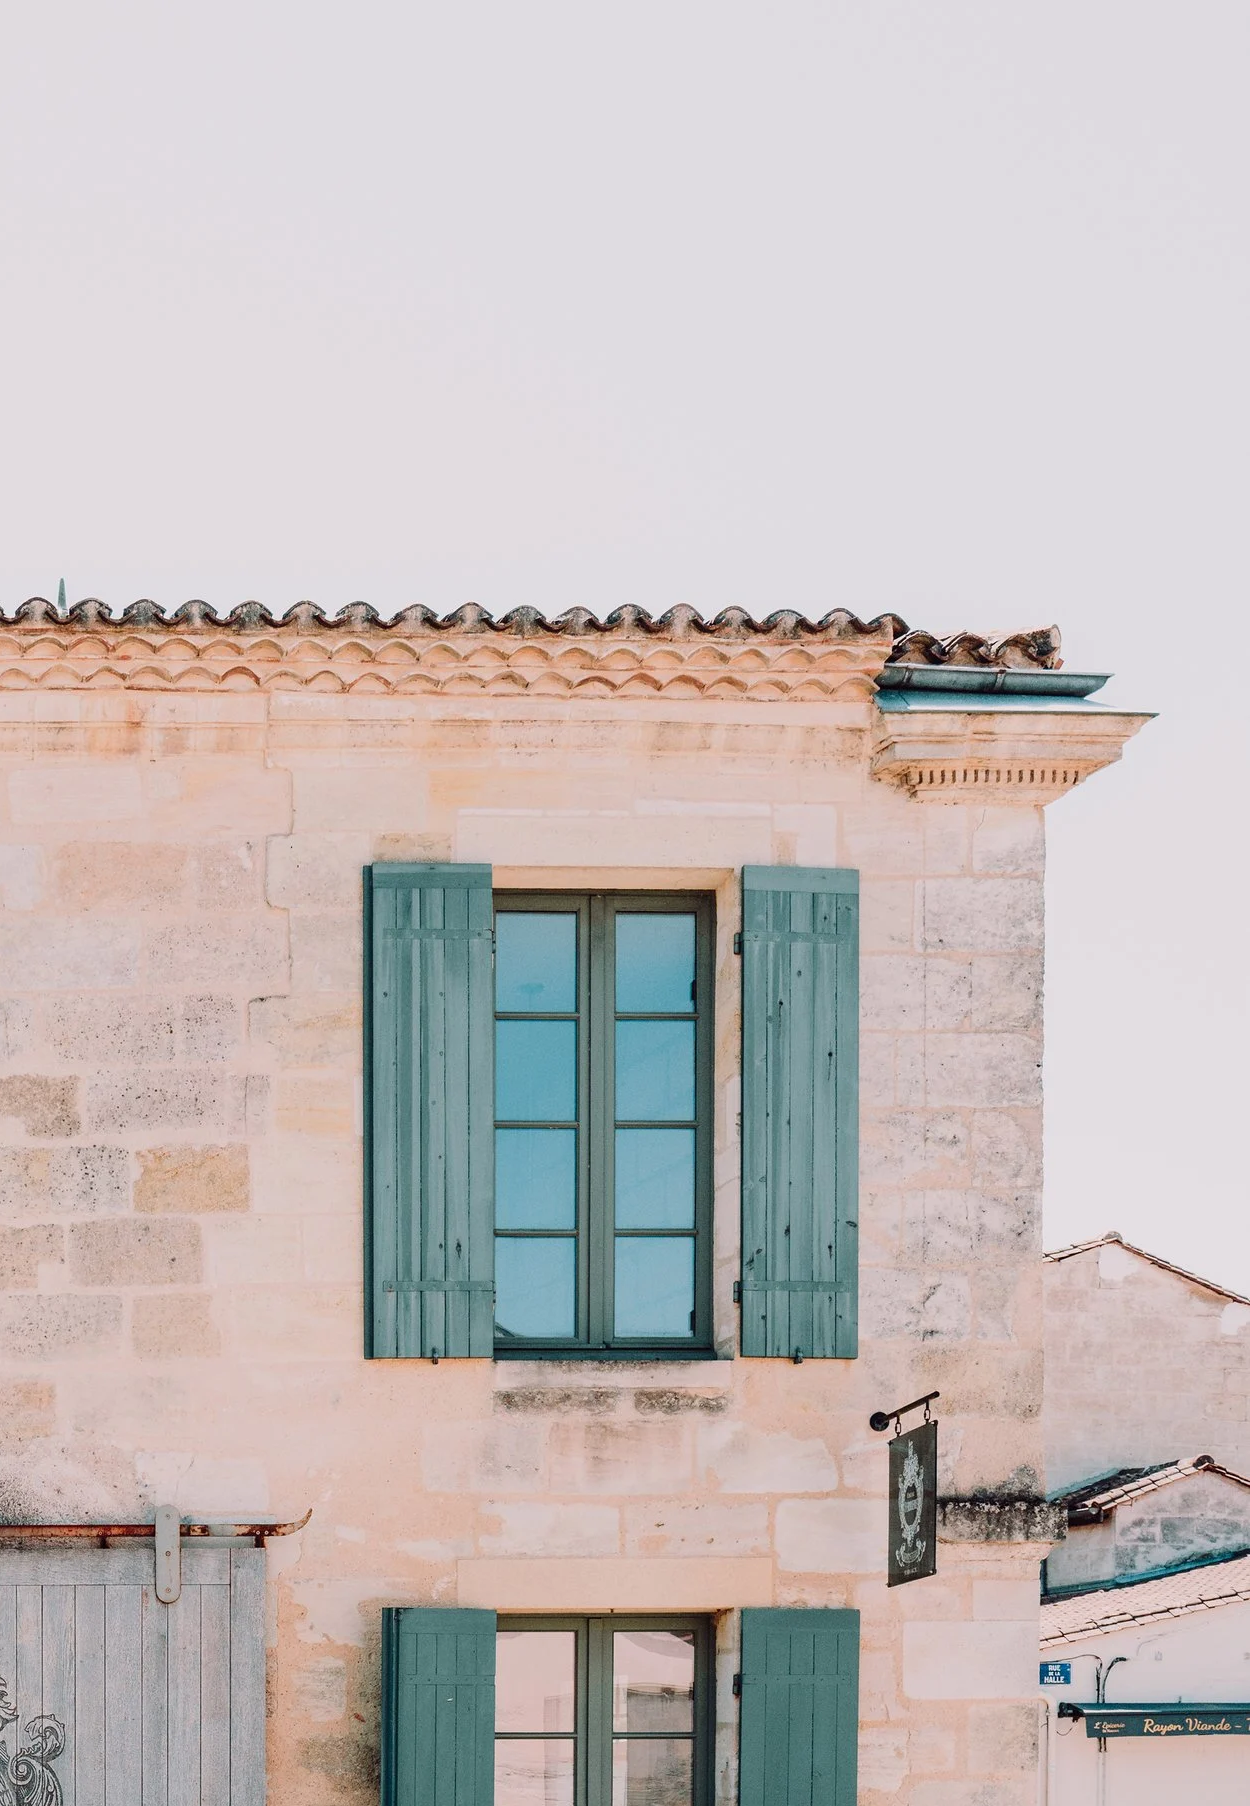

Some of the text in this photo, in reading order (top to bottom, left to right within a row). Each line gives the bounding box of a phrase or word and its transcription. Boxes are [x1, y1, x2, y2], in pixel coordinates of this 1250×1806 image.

[1044, 1676, 1065, 1684] HALLE
[1143, 1718, 1184, 1735] Rayon
[1185, 1717, 1232, 1731] Viande
